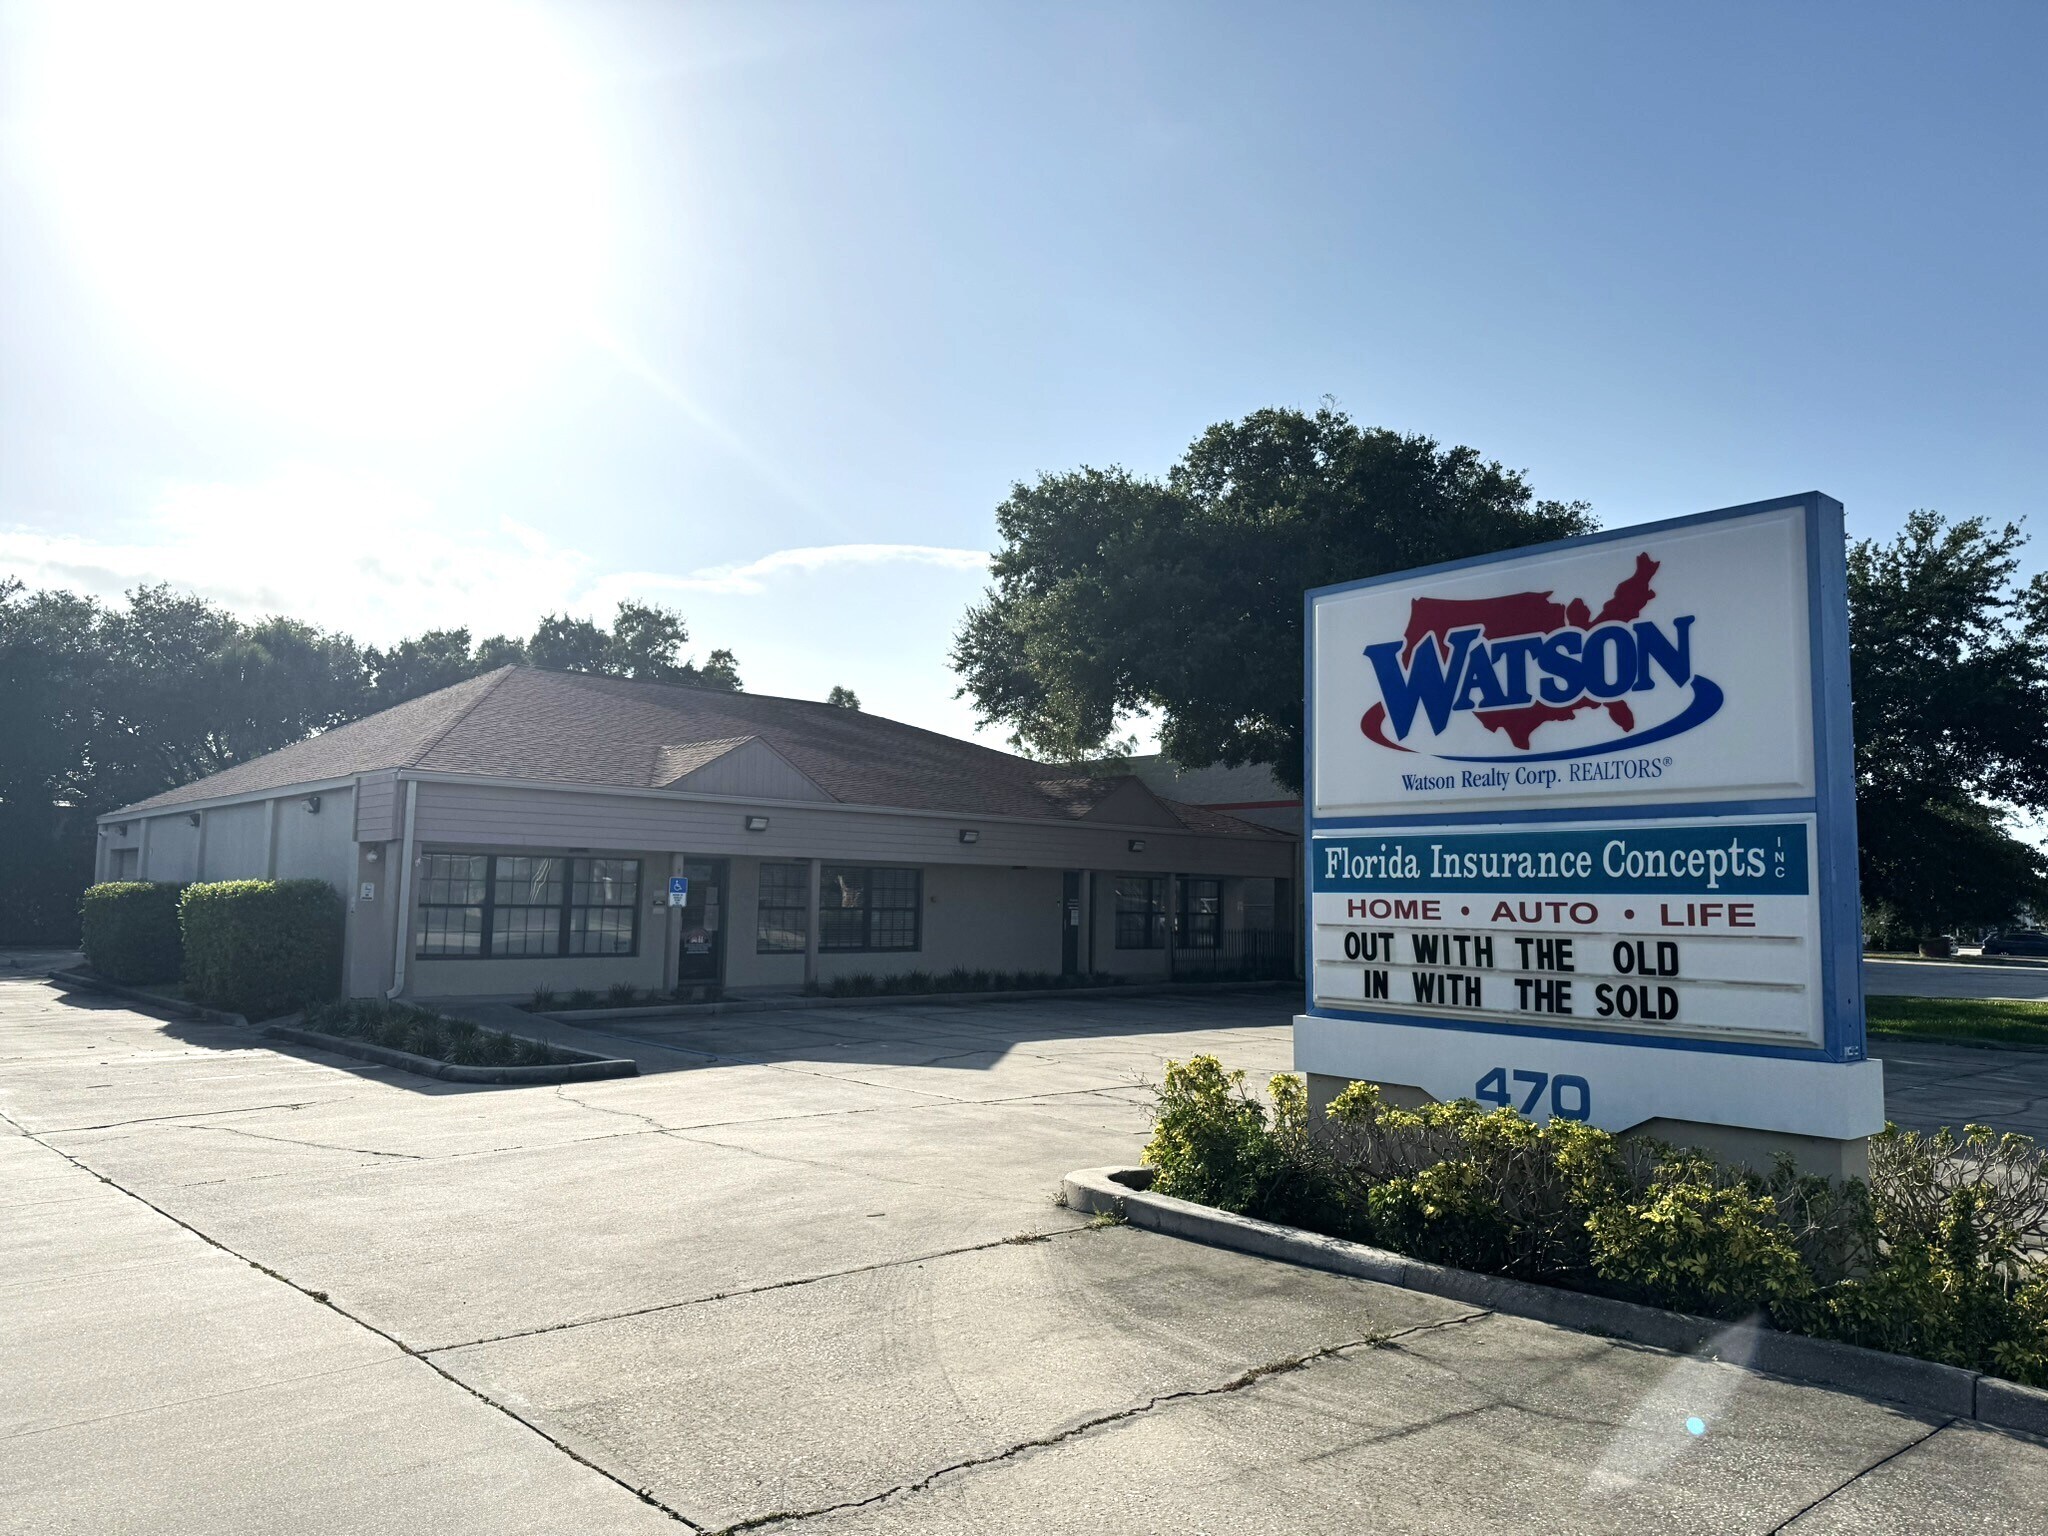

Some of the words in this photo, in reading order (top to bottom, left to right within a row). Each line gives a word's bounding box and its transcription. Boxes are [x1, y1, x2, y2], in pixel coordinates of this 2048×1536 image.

[1363, 615, 1695, 741] WATSON
[1402, 774, 1454, 791] Watson
[1461, 767, 1510, 790] Realty
[1515, 766, 1561, 789] Corp.
[1325, 843, 1421, 879] Florida
[1430, 844, 1592, 878] Insurance
[1602, 837, 1766, 889] Concepts
[1774, 836, 1785, 878] INC
[1347, 899, 1441, 920] HOME
[1491, 901, 1598, 924] AUTO
[1660, 903, 1756, 927] LIFE
[1344, 931, 1394, 962] OUT
[1412, 934, 1494, 968] WITH
[1514, 938, 1575, 972] THE
[1612, 941, 1679, 976] OLD
[1364, 970, 1388, 999] IN
[1412, 972, 1481, 1007] WITH
[1514, 979, 1572, 1014] THE
[1595, 983, 1679, 1020] SOLD
[1475, 1067, 1591, 1122] 470
